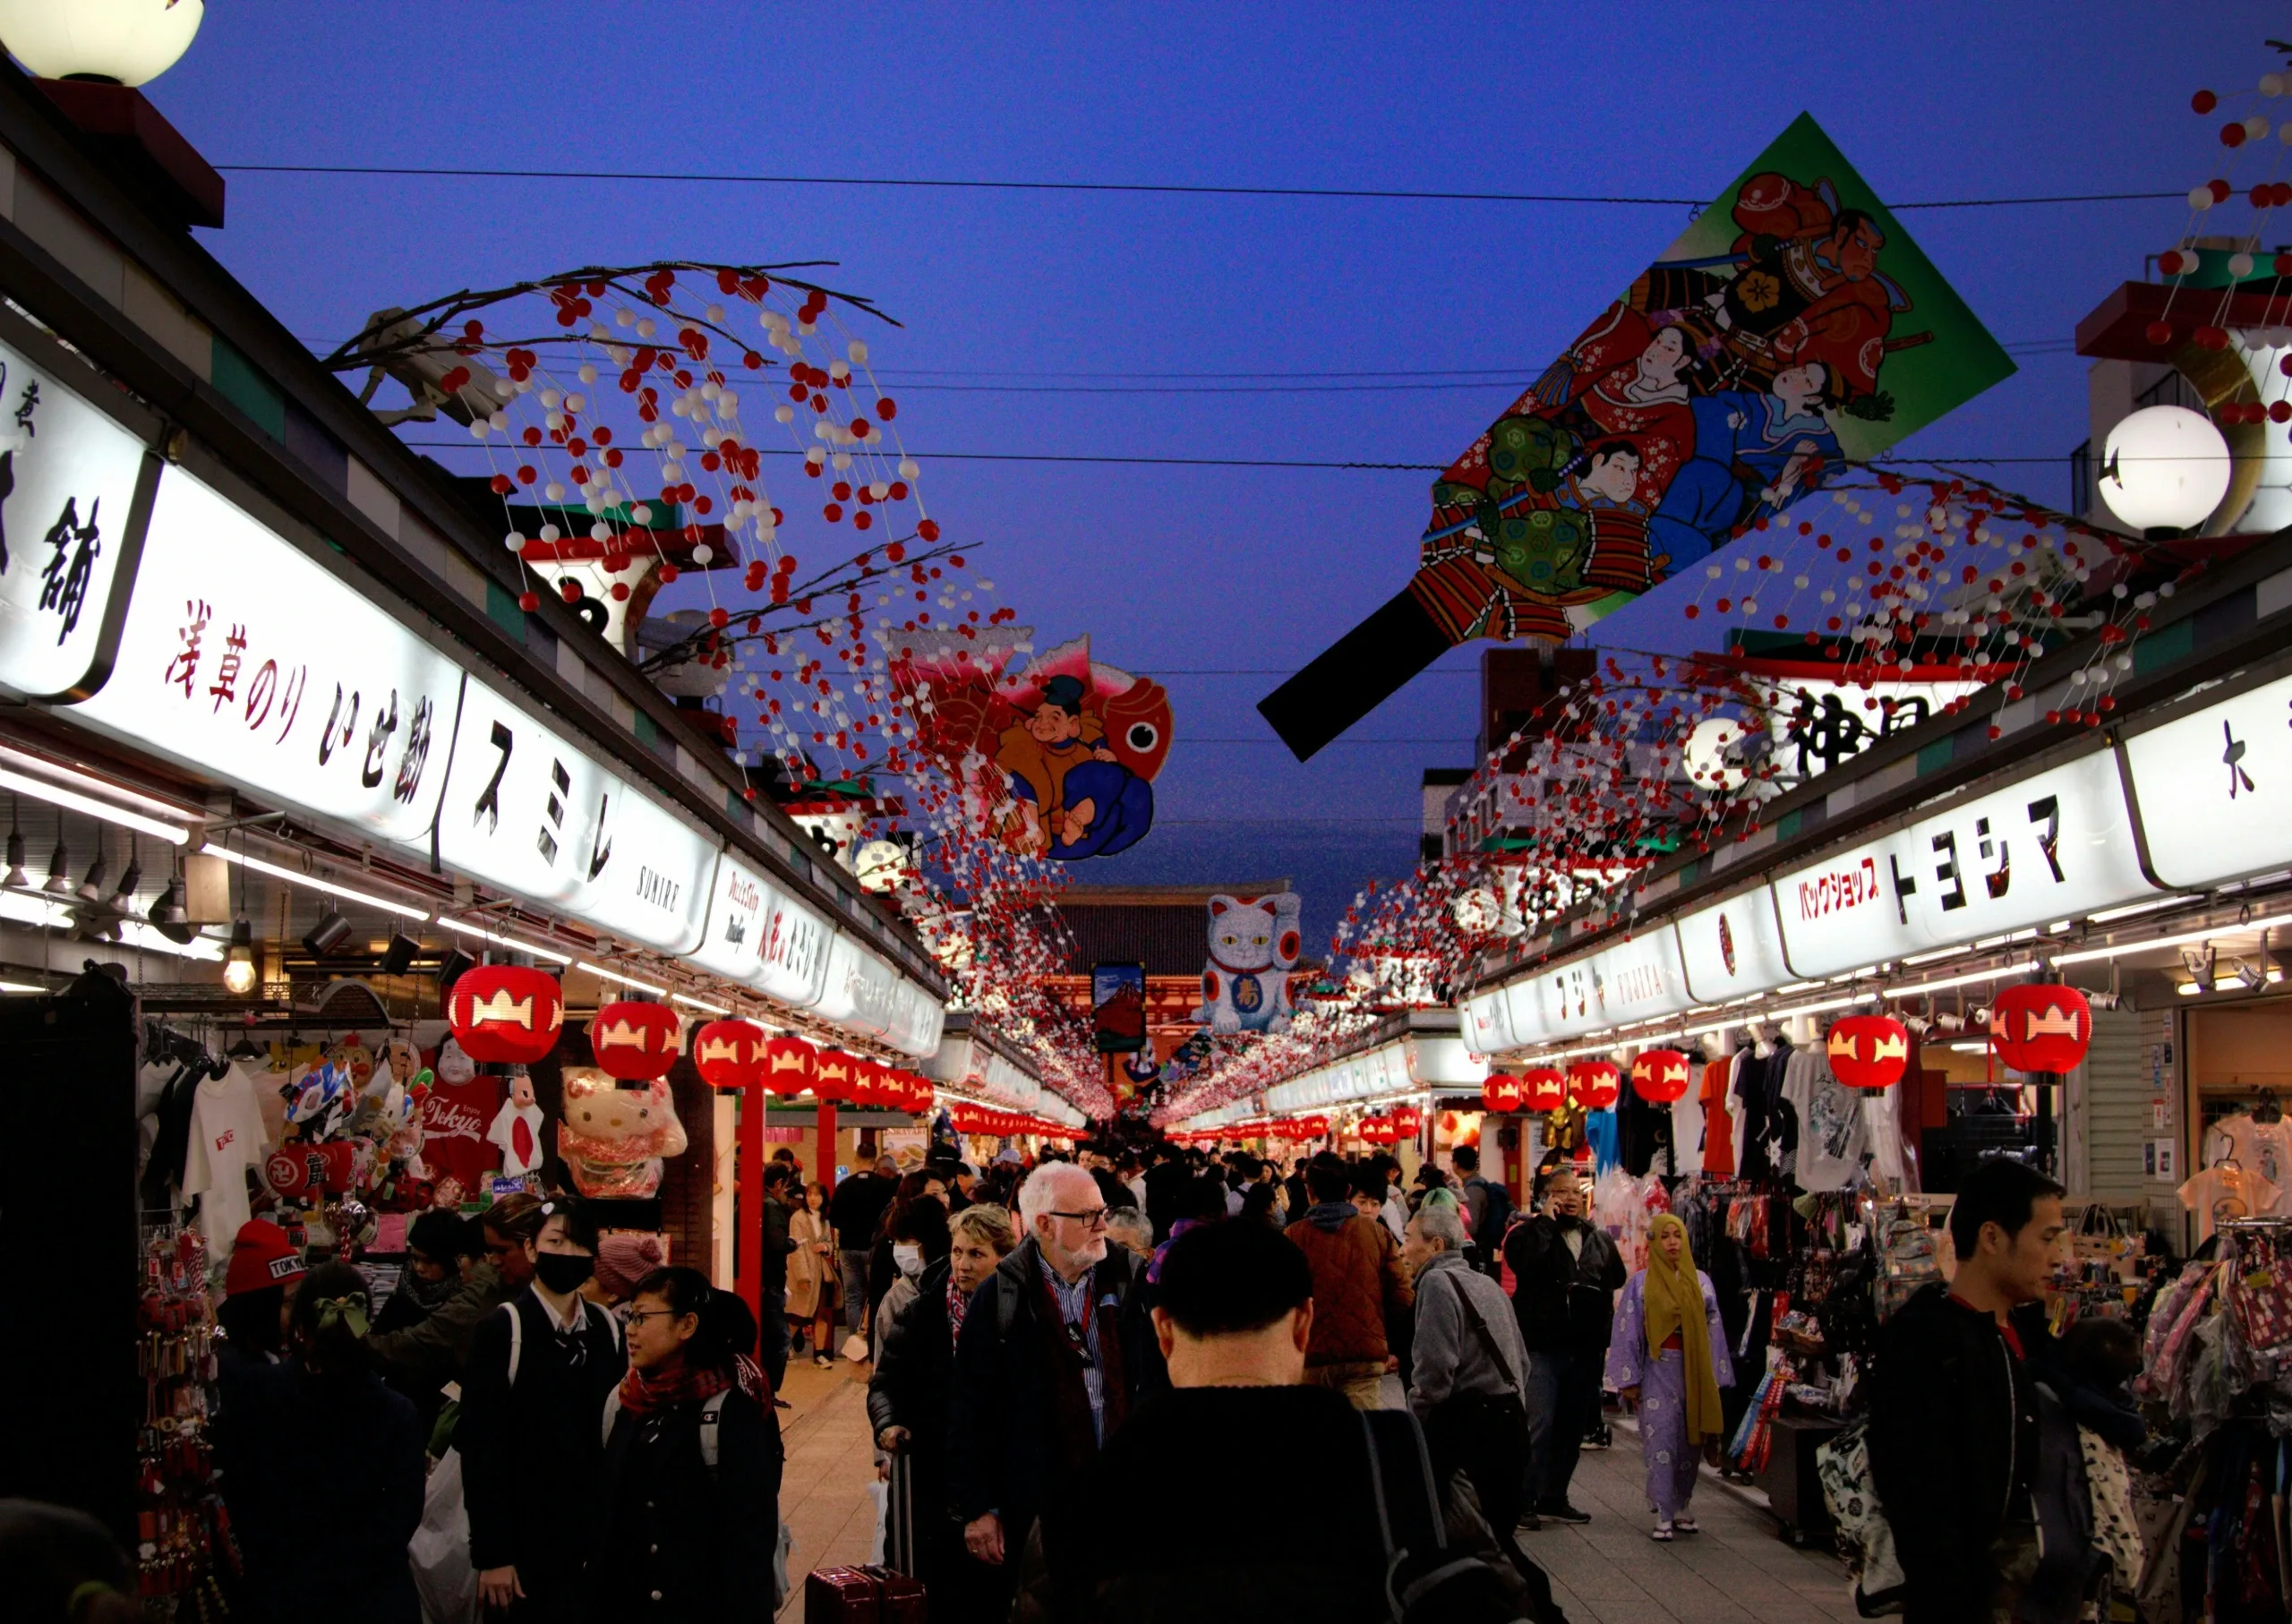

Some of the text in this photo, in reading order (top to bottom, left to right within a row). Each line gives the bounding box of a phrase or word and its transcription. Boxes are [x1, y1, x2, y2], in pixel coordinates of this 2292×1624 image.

[166, 599, 306, 745] 浅草のり
[474, 719, 680, 912] スミレ SUMIRE
[1889, 794, 2066, 926] トヨシマ
[1617, 964, 1663, 1004] FUJIYA
[422, 1096, 483, 1138] Tokyo
[462, 1105, 482, 1116] Enjoy
